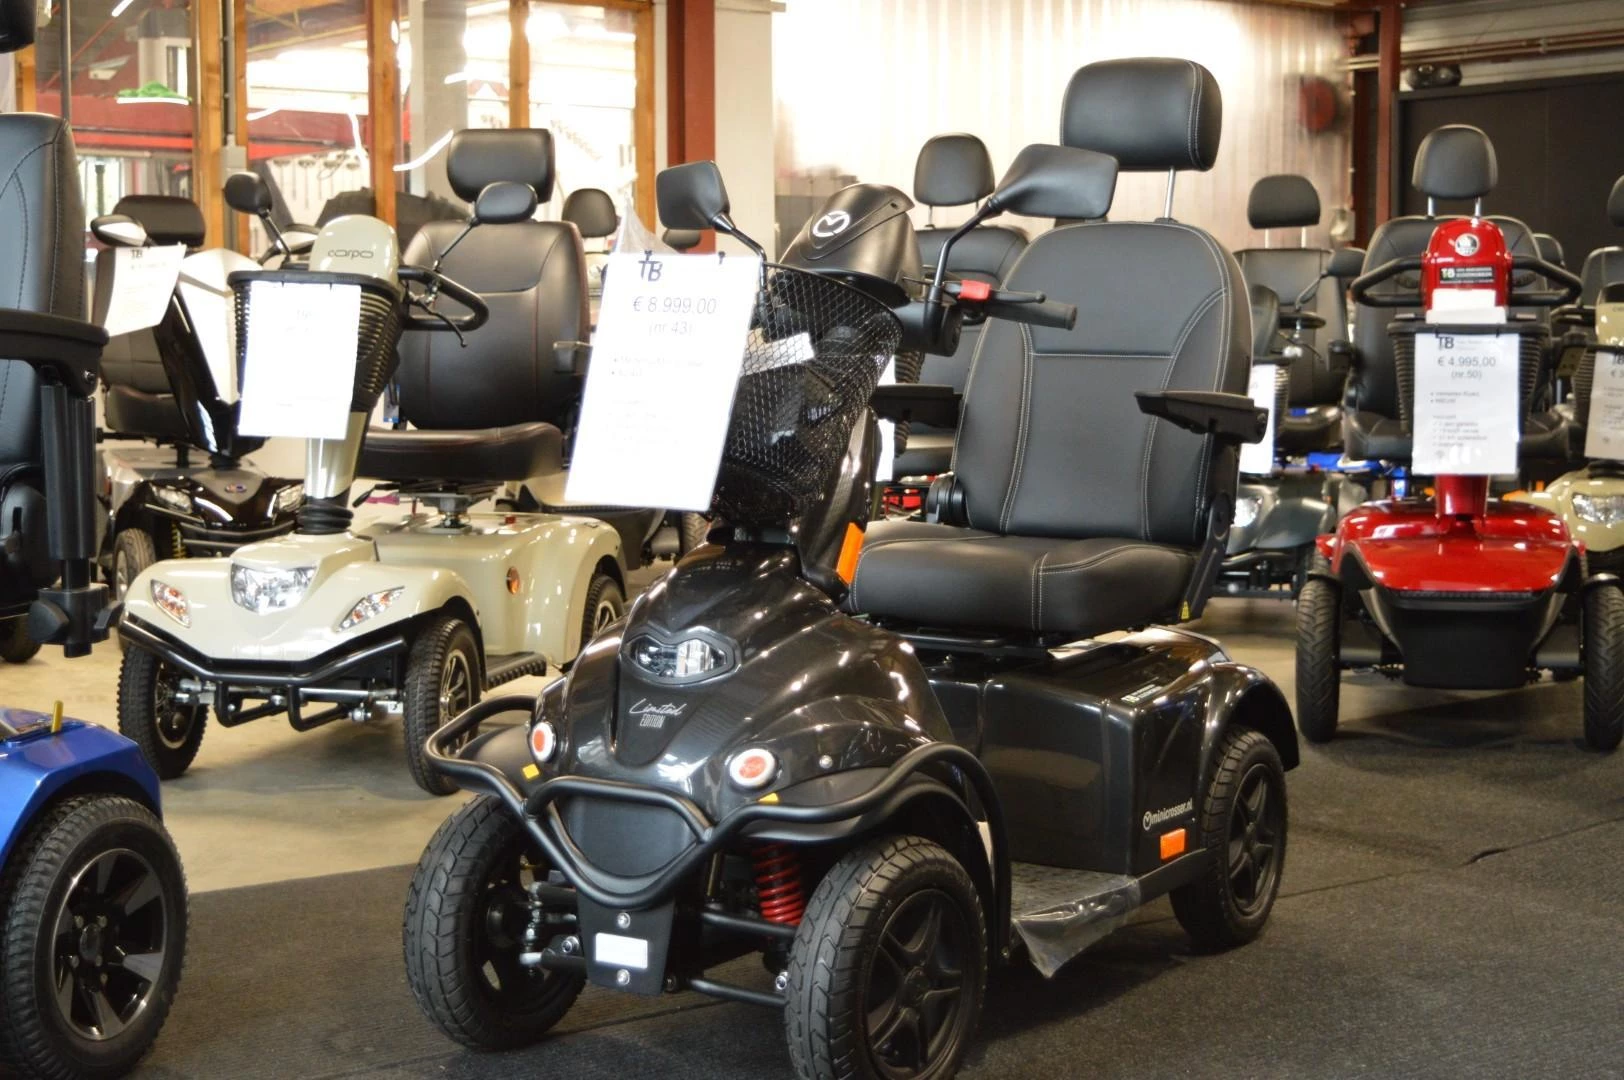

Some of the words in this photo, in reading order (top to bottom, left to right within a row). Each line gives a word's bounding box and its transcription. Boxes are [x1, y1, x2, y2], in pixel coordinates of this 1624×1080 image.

[328, 249, 374, 260] carpo
[638, 260, 663, 282] TB
[633, 296, 644, 312] €
[1437, 336, 1455, 350] TB
[1437, 356, 1445, 367] €
